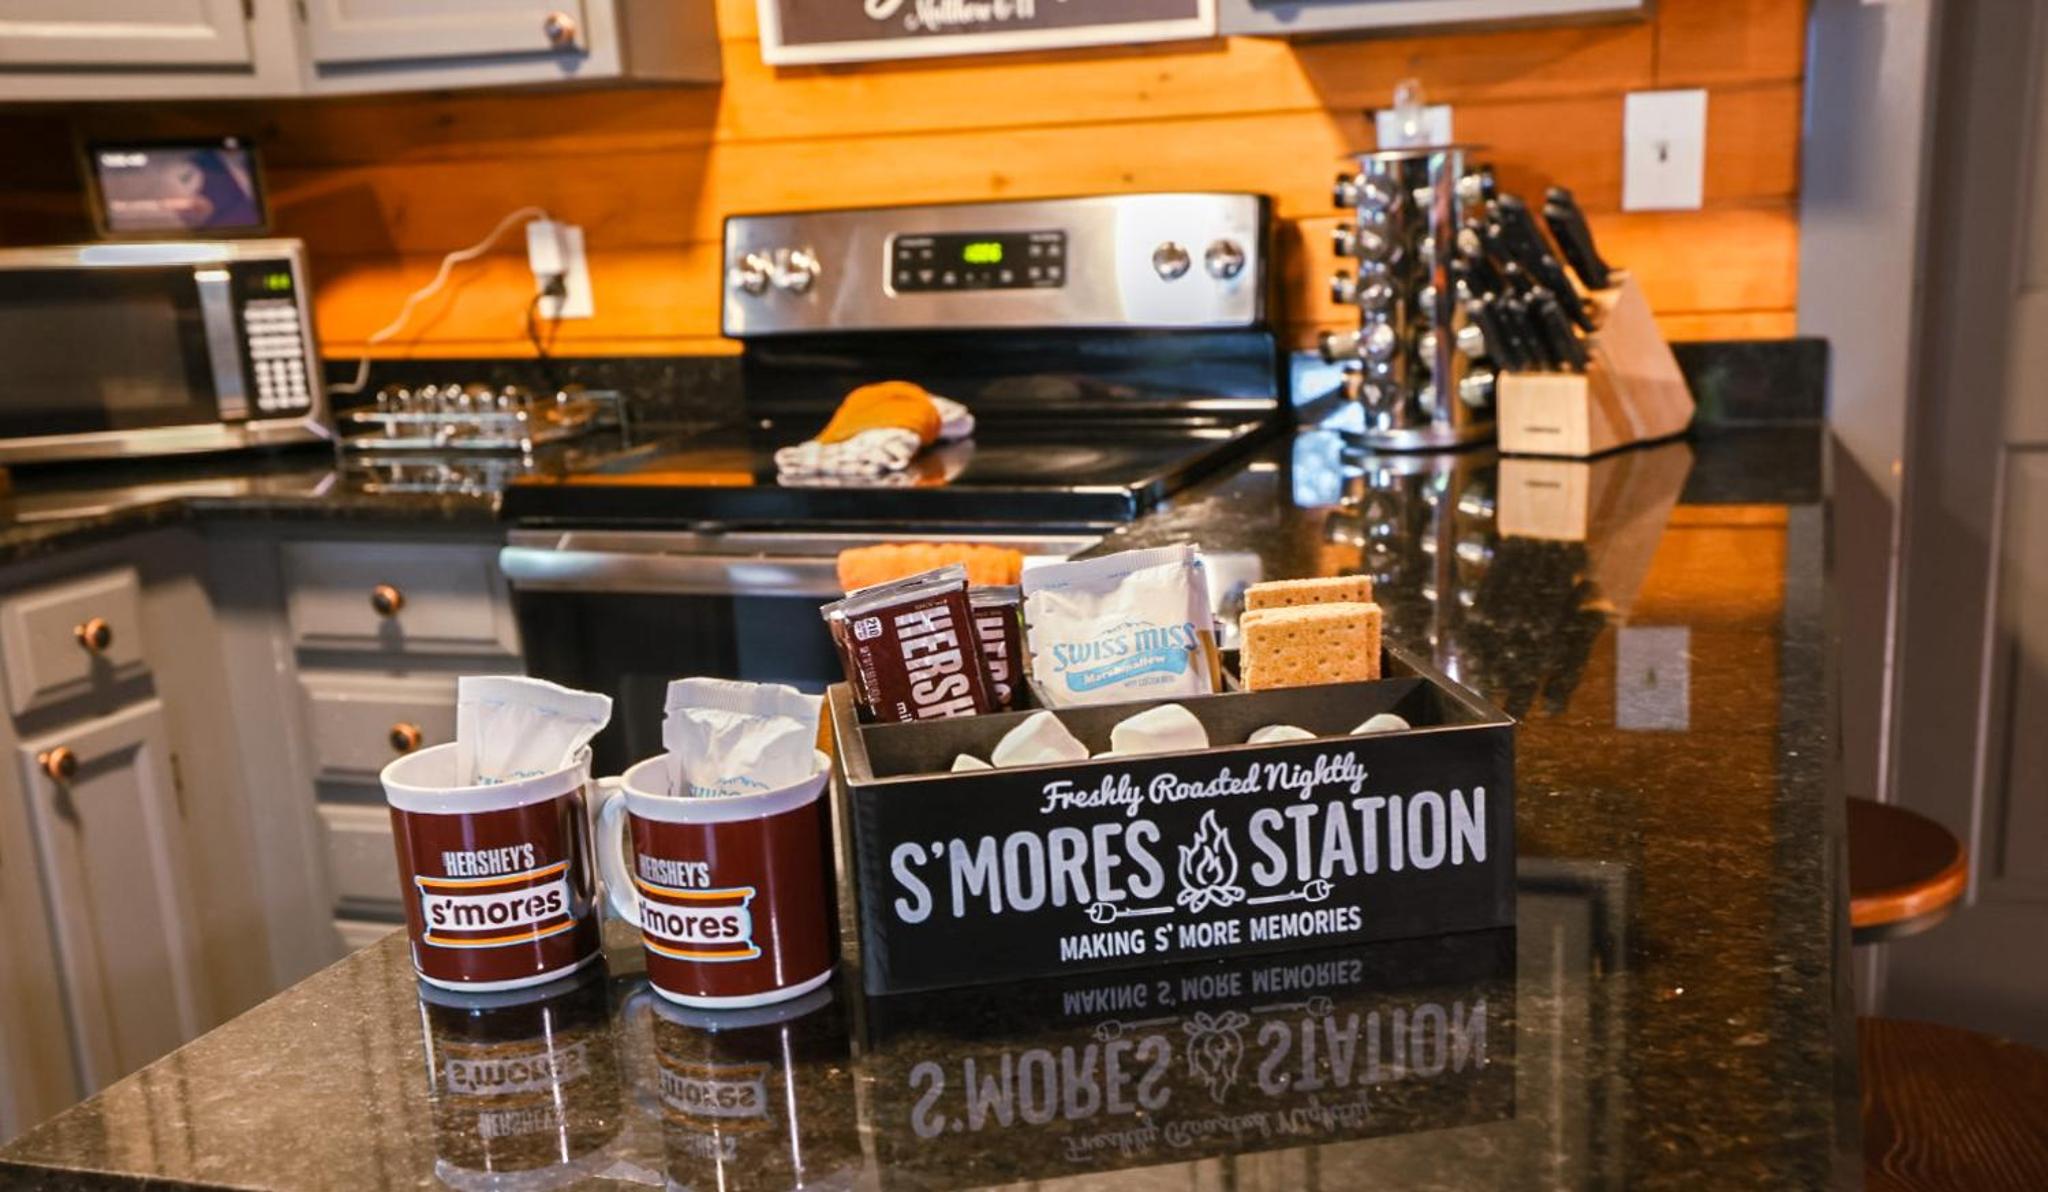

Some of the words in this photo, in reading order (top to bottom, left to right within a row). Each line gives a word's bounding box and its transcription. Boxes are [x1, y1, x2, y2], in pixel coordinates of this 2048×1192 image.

[1040, 773, 1144, 817] Freshly
[1149, 762, 1262, 803] Roasted
[1264, 751, 1368, 800] Nightly
[442, 842, 535, 877] HERSHEY'S
[890, 819, 1165, 924] S'MORES
[1249, 786, 1486, 887] STATION
[431, 889, 562, 927] s'mores
[1060, 929, 1146, 962] MAKING
[1179, 919, 1242, 950] MORE
[1250, 905, 1362, 942] MEMORIES
